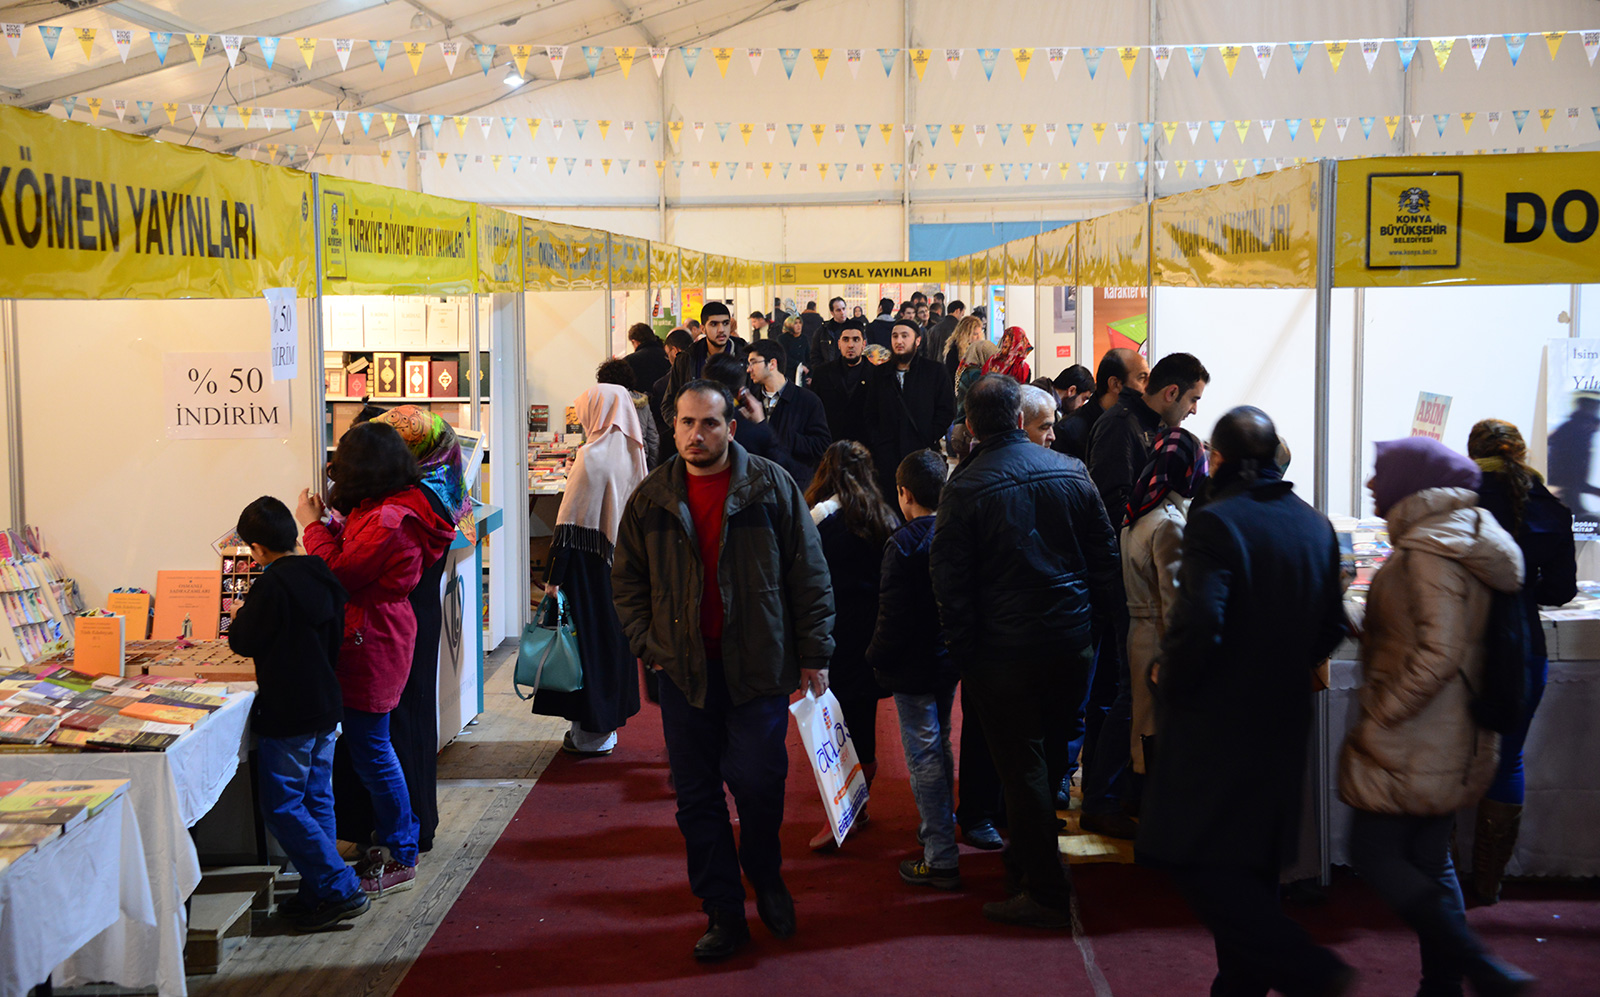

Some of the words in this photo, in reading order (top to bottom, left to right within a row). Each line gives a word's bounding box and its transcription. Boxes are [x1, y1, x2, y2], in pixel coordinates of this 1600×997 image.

[126, 185, 257, 260] YAYINLARI
[1229, 203, 1290, 255] YAYINLARI
[1380, 223, 1447, 236] BÜYÜKŞEHİR
[1396, 215, 1432, 224] KONYA
[348, 209, 383, 254] TÜRKİYE
[384, 213, 415, 255] DİYANET
[415, 226, 434, 257] VAKFI
[434, 228, 466, 259] YAYINLARI
[1393, 235, 1433, 244] BELEDİYESİ
[823, 268, 864, 279] UYSAL
[867, 267, 932, 278] YAYINLARI
[279, 304, 292, 332] 50
[188, 367, 218, 395] %
[229, 367, 263, 394] 50
[176, 402, 279, 426] İNDİRİM
[1416, 396, 1446, 427] ABİM
